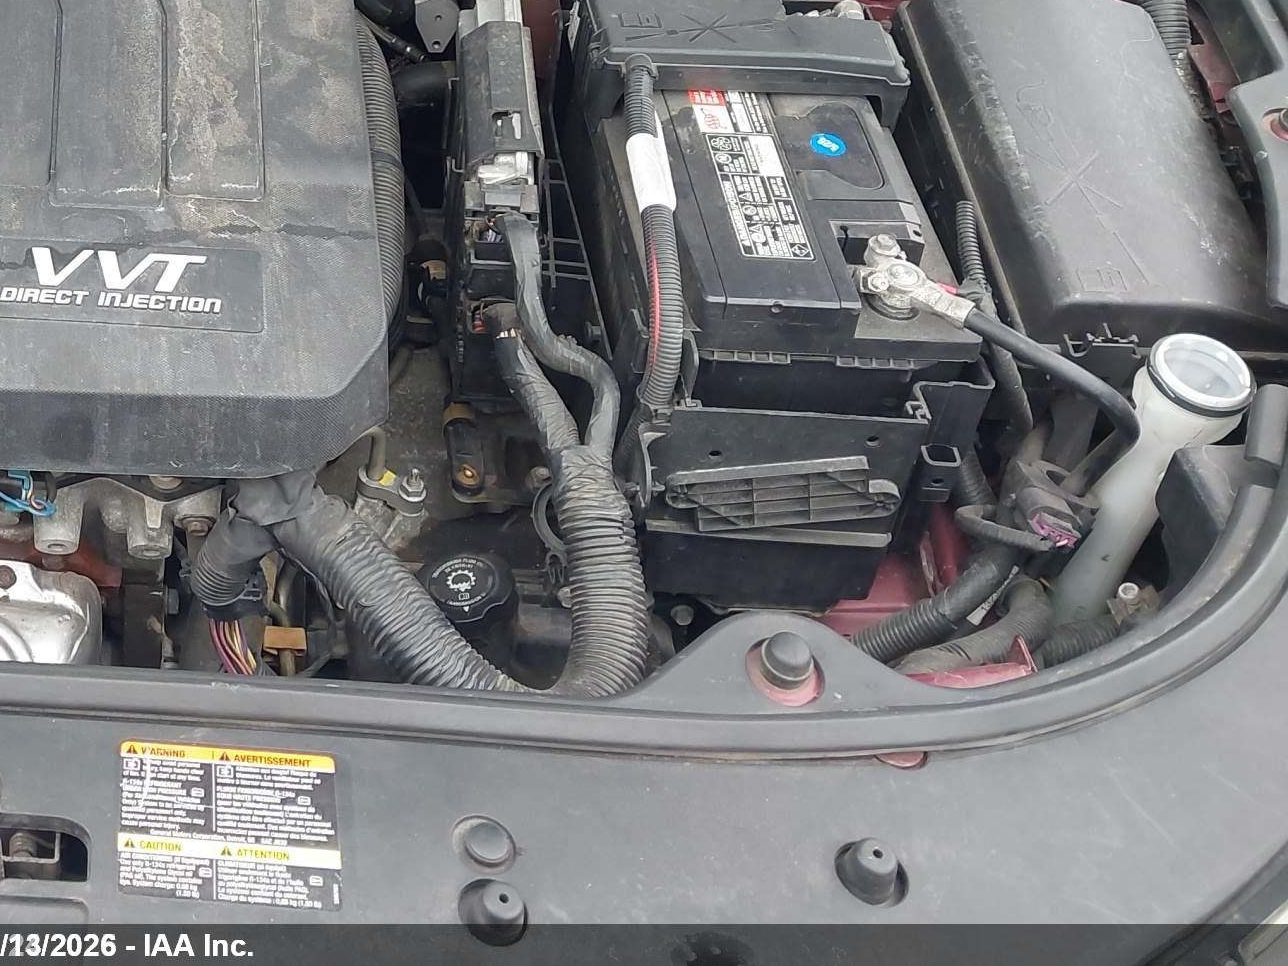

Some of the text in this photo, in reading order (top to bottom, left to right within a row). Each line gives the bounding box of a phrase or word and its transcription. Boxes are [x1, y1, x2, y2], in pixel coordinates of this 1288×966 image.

[32, 247, 207, 292] VVT
[0, 287, 222, 314] DIRECT INJECTION
[234, 754, 312, 767] AVERTISSEMENT
[140, 841, 182, 851] CAUTION
[237, 849, 290, 860] ATTENTION
